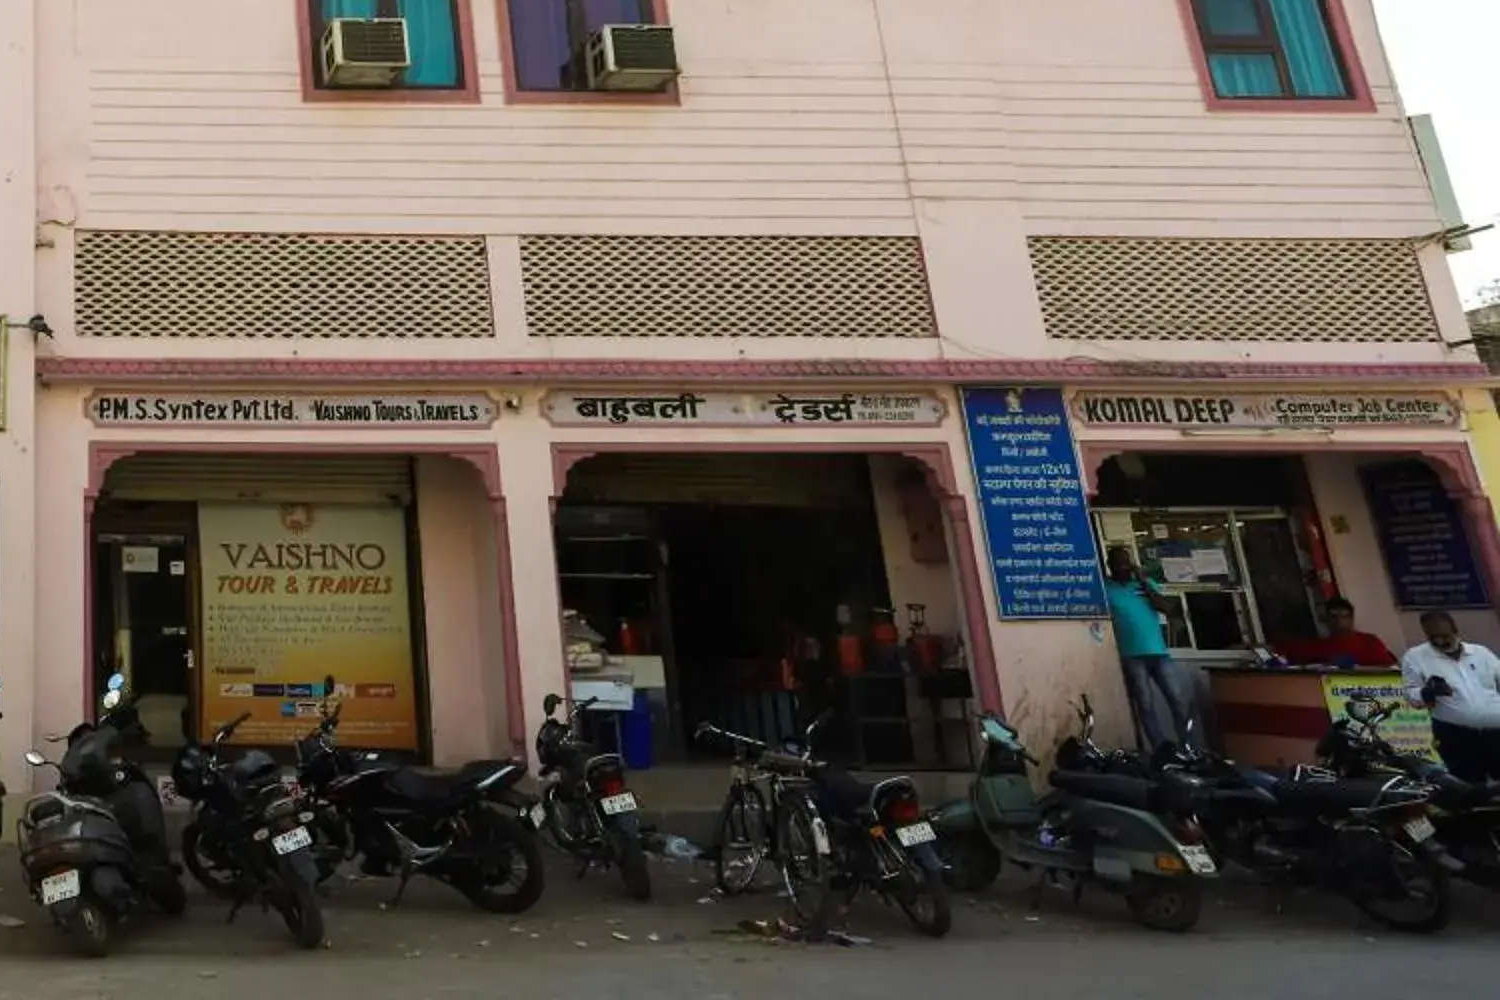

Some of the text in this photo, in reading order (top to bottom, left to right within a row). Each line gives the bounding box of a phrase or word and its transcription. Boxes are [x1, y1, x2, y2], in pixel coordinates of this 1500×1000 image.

[313, 400, 371, 422] VAISHNO
[372, 400, 413, 422] TOURS
[417, 400, 479, 421] TRAVELS
[573, 393, 856, 424] बाहुबली ट्रेडर्स
[1085, 397, 1172, 423] KOMAL
[1174, 398, 1234, 423] DEEP
[1274, 398, 1352, 416] Computer
[1386, 400, 1441, 414] Center
[220, 543, 385, 570] VAISHNO
[217, 576, 393, 595] TOUR & TRAVELS
